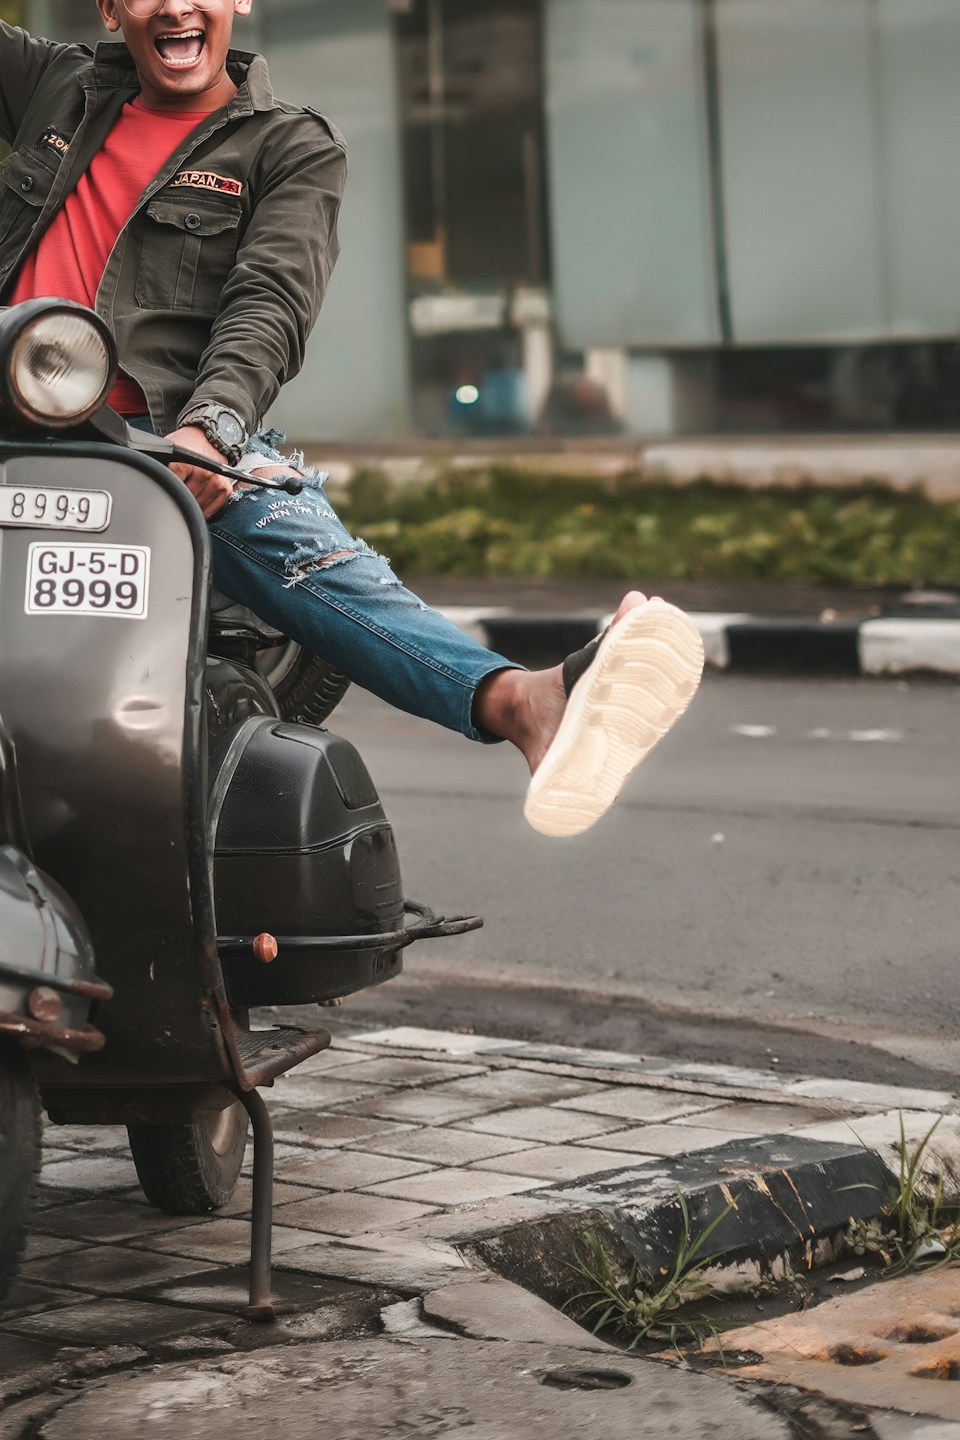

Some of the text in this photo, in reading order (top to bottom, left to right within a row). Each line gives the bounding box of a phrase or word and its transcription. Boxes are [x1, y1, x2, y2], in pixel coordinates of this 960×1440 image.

[220, 181, 238, 193] 23
[11, 492, 90, 523] 8999
[268, 499, 303, 511] WAKE
[256, 508, 290, 529] WHEN
[294, 506, 312, 515] I'M
[38, 550, 139, 576] GJ-5-D
[33, 578, 138, 610] 8999
